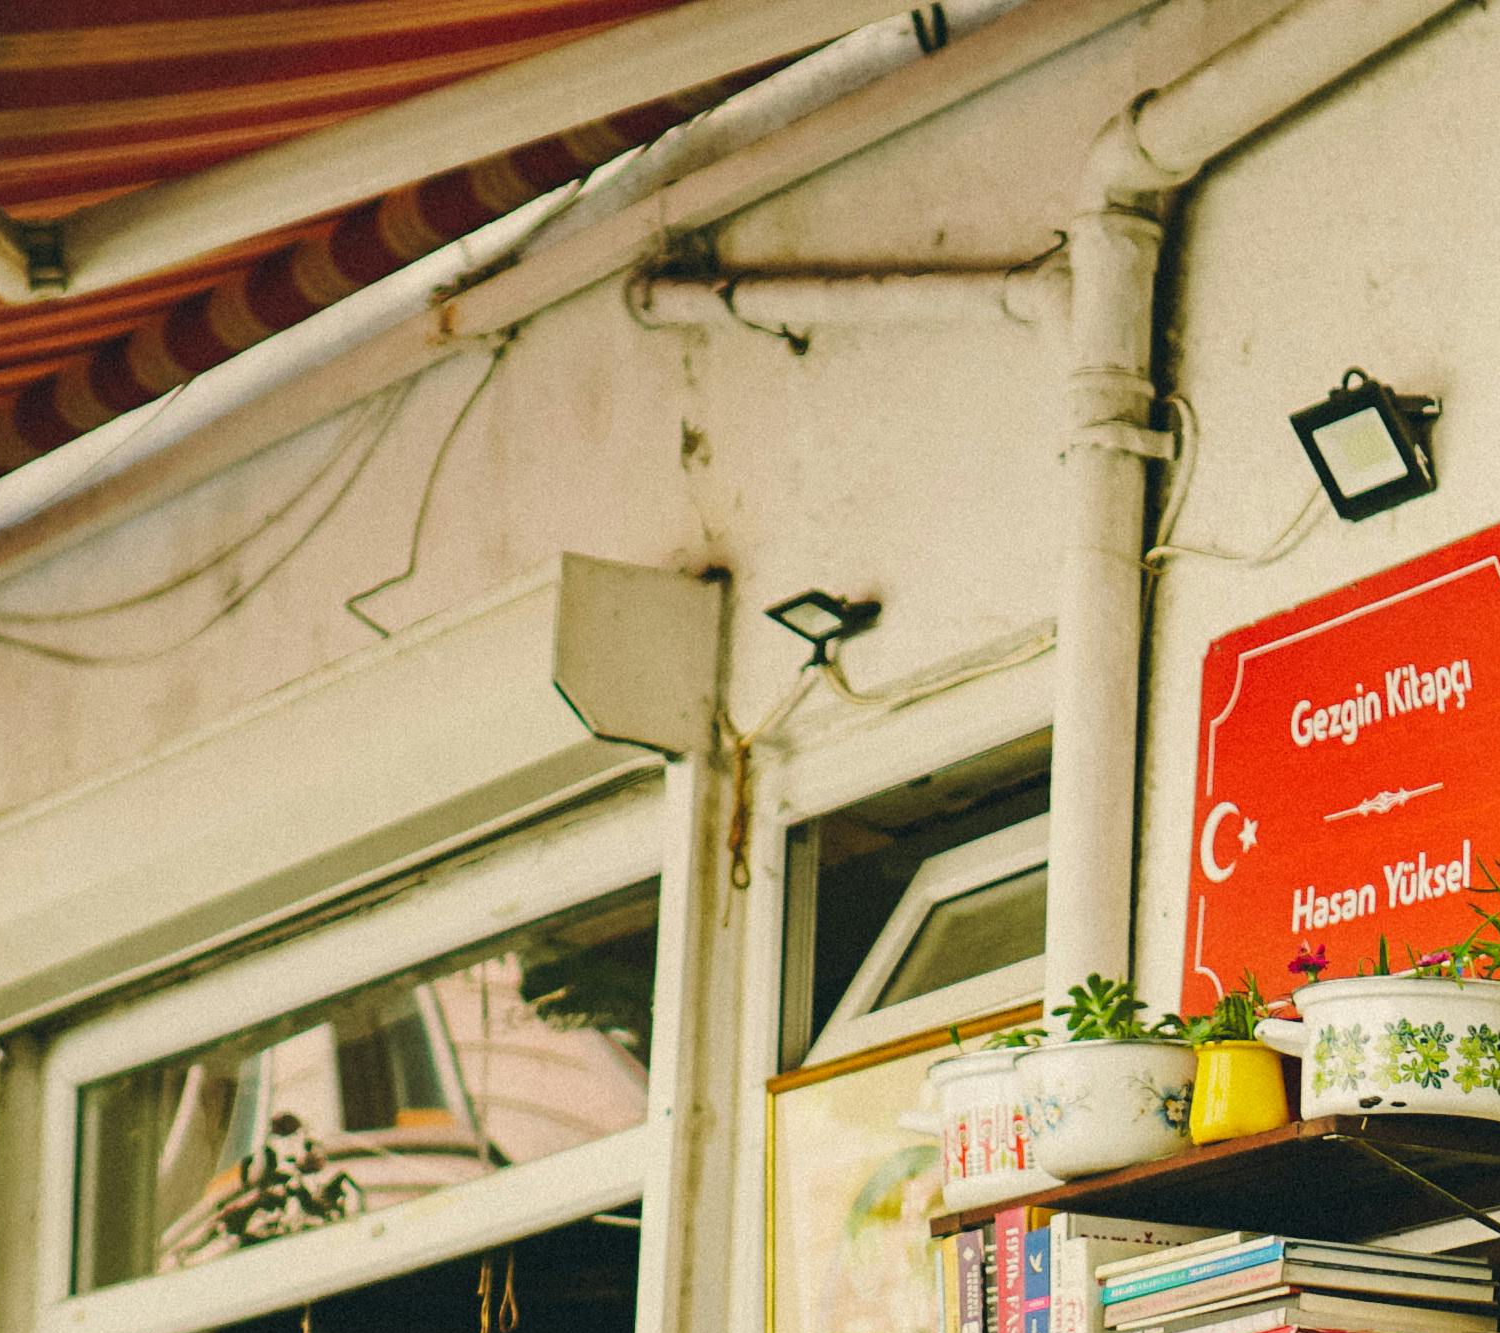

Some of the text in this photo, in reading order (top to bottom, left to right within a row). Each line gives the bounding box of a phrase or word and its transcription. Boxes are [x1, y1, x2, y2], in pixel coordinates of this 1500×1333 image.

[1290, 659, 1472, 747] Gezgin Kitapçı
[1291, 839, 1471, 934] Hasan Yüksel
